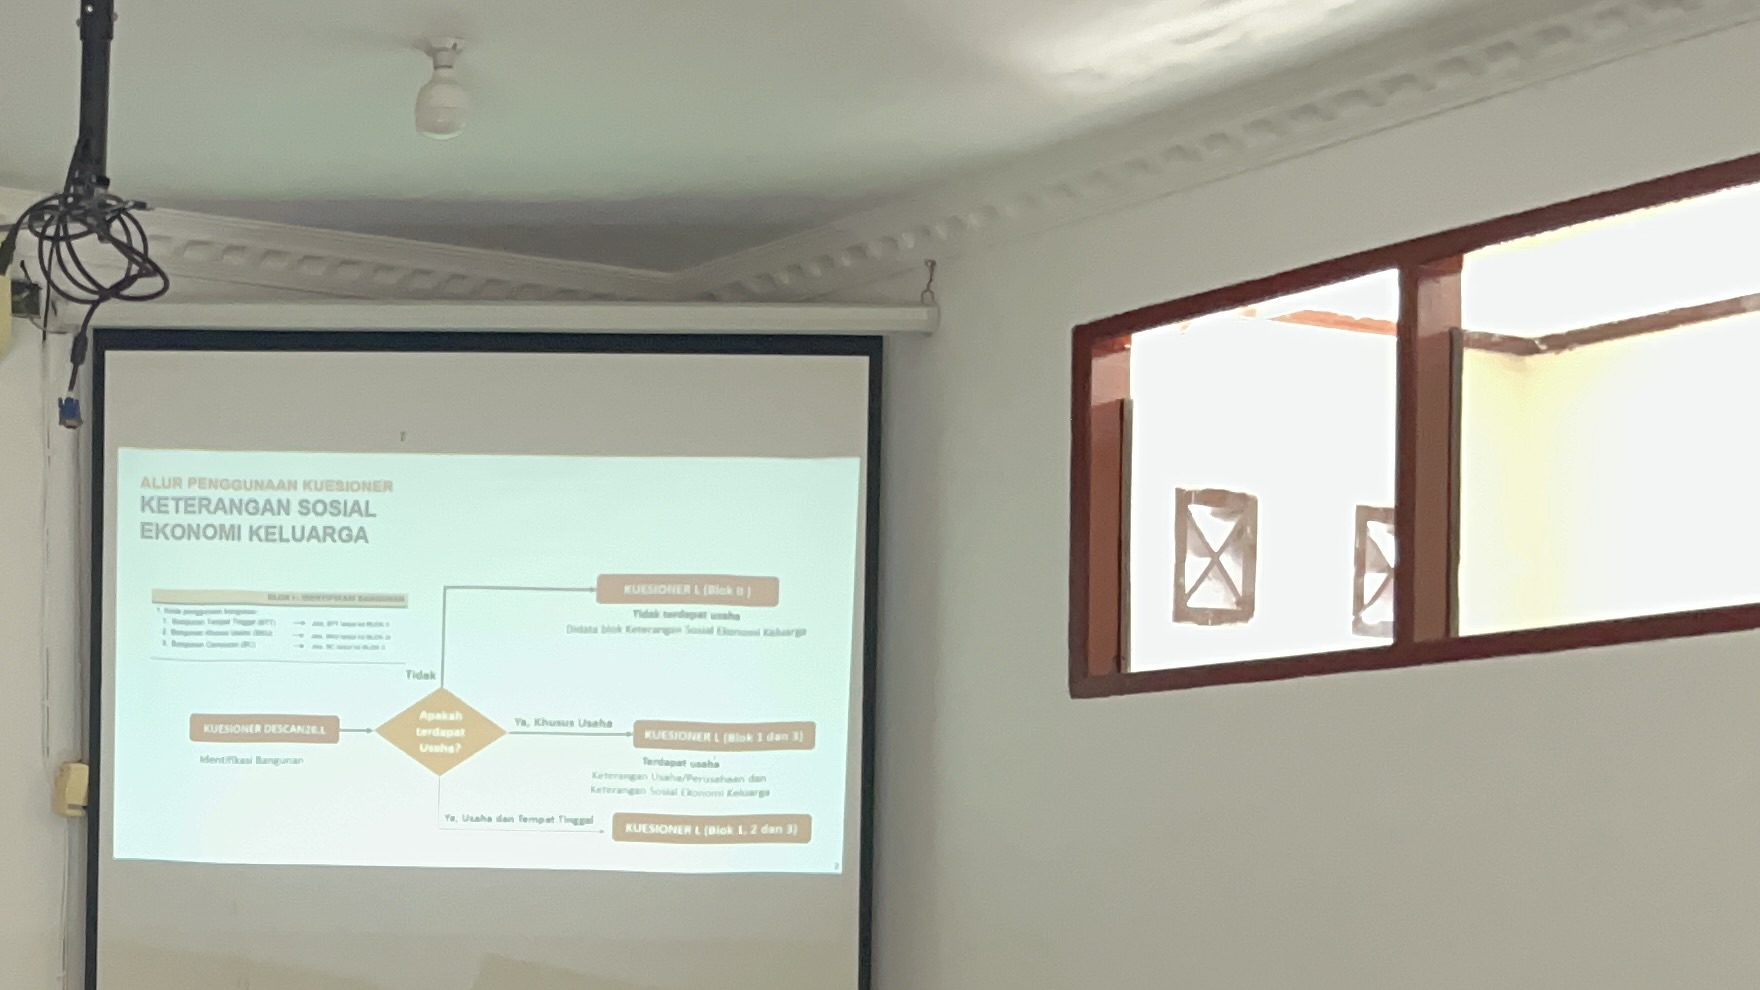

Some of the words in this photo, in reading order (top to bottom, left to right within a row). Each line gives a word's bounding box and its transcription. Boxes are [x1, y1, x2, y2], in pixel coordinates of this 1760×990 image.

[141, 476, 183, 490] ALUR
[188, 477, 298, 492] PENGGUNAAN
[303, 479, 393, 493] KUESIONER
[141, 496, 291, 516] KETERANGAN
[297, 498, 377, 518] SOSIAL
[141, 522, 241, 541] EKONOMI
[248, 525, 369, 544] KELUARGA
[623, 584, 690, 595] KUESIONER
[633, 609, 659, 620] Tidak
[406, 670, 436, 681] Tidak
[419, 710, 463, 722] Apakah
[203, 723, 261, 734] KUESIONER
[416, 726, 465, 739] terdapat
[644, 730, 711, 742] KUESIONER
[419, 742, 461, 754] Usaha?
[625, 823, 691, 835] KUESIONER
